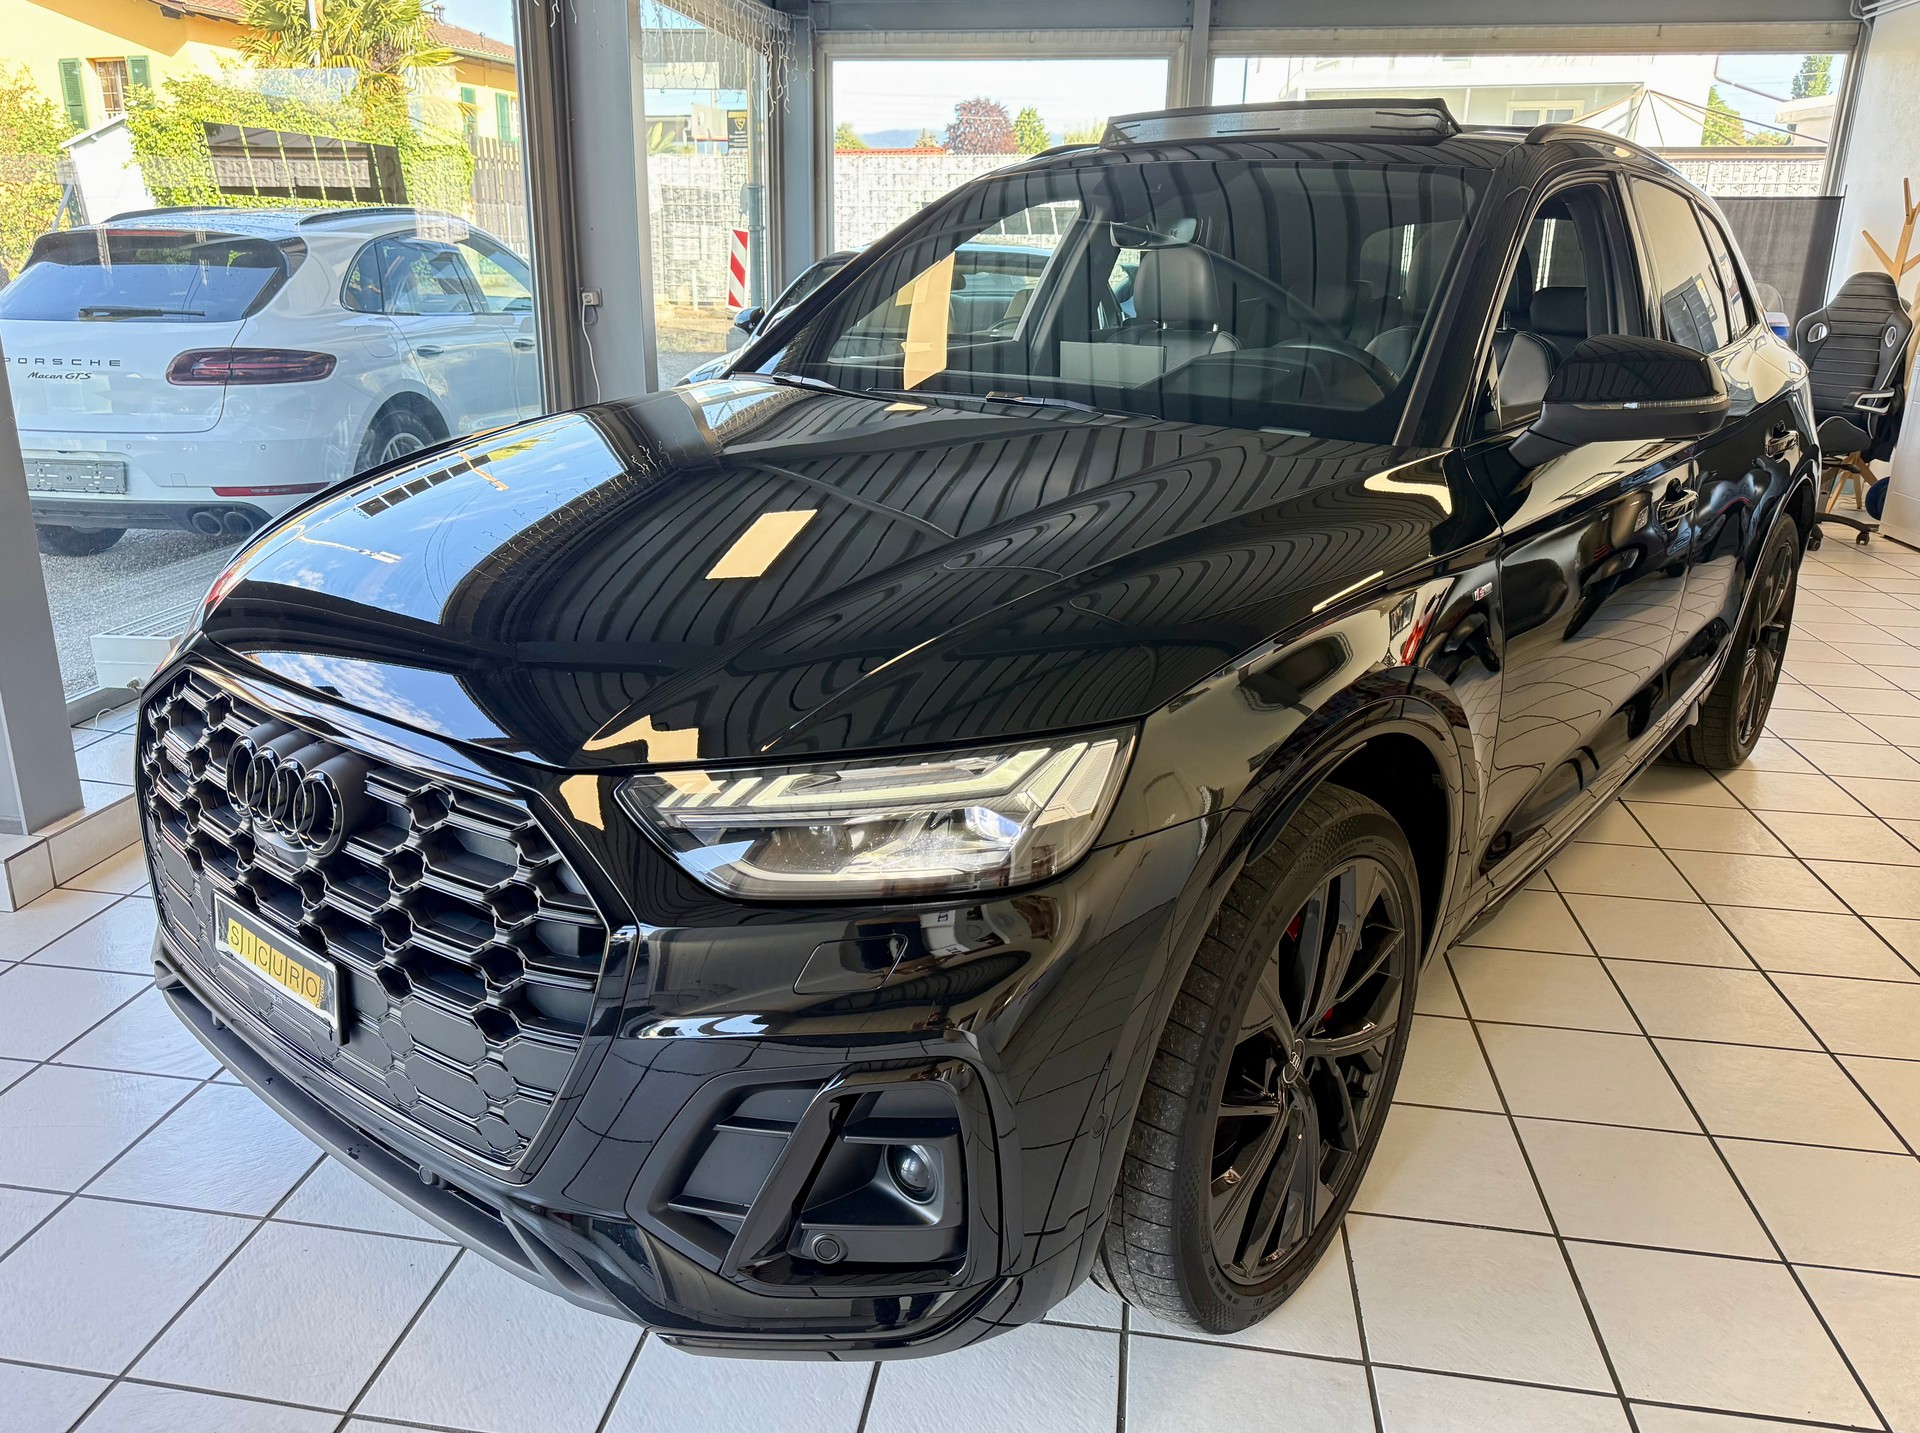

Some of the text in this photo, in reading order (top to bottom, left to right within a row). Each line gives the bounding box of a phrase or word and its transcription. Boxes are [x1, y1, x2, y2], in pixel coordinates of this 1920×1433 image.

[27, 372, 92, 380] Macan GTS
[1197, 903, 1284, 1115] 255/40 ZR 21 XL
